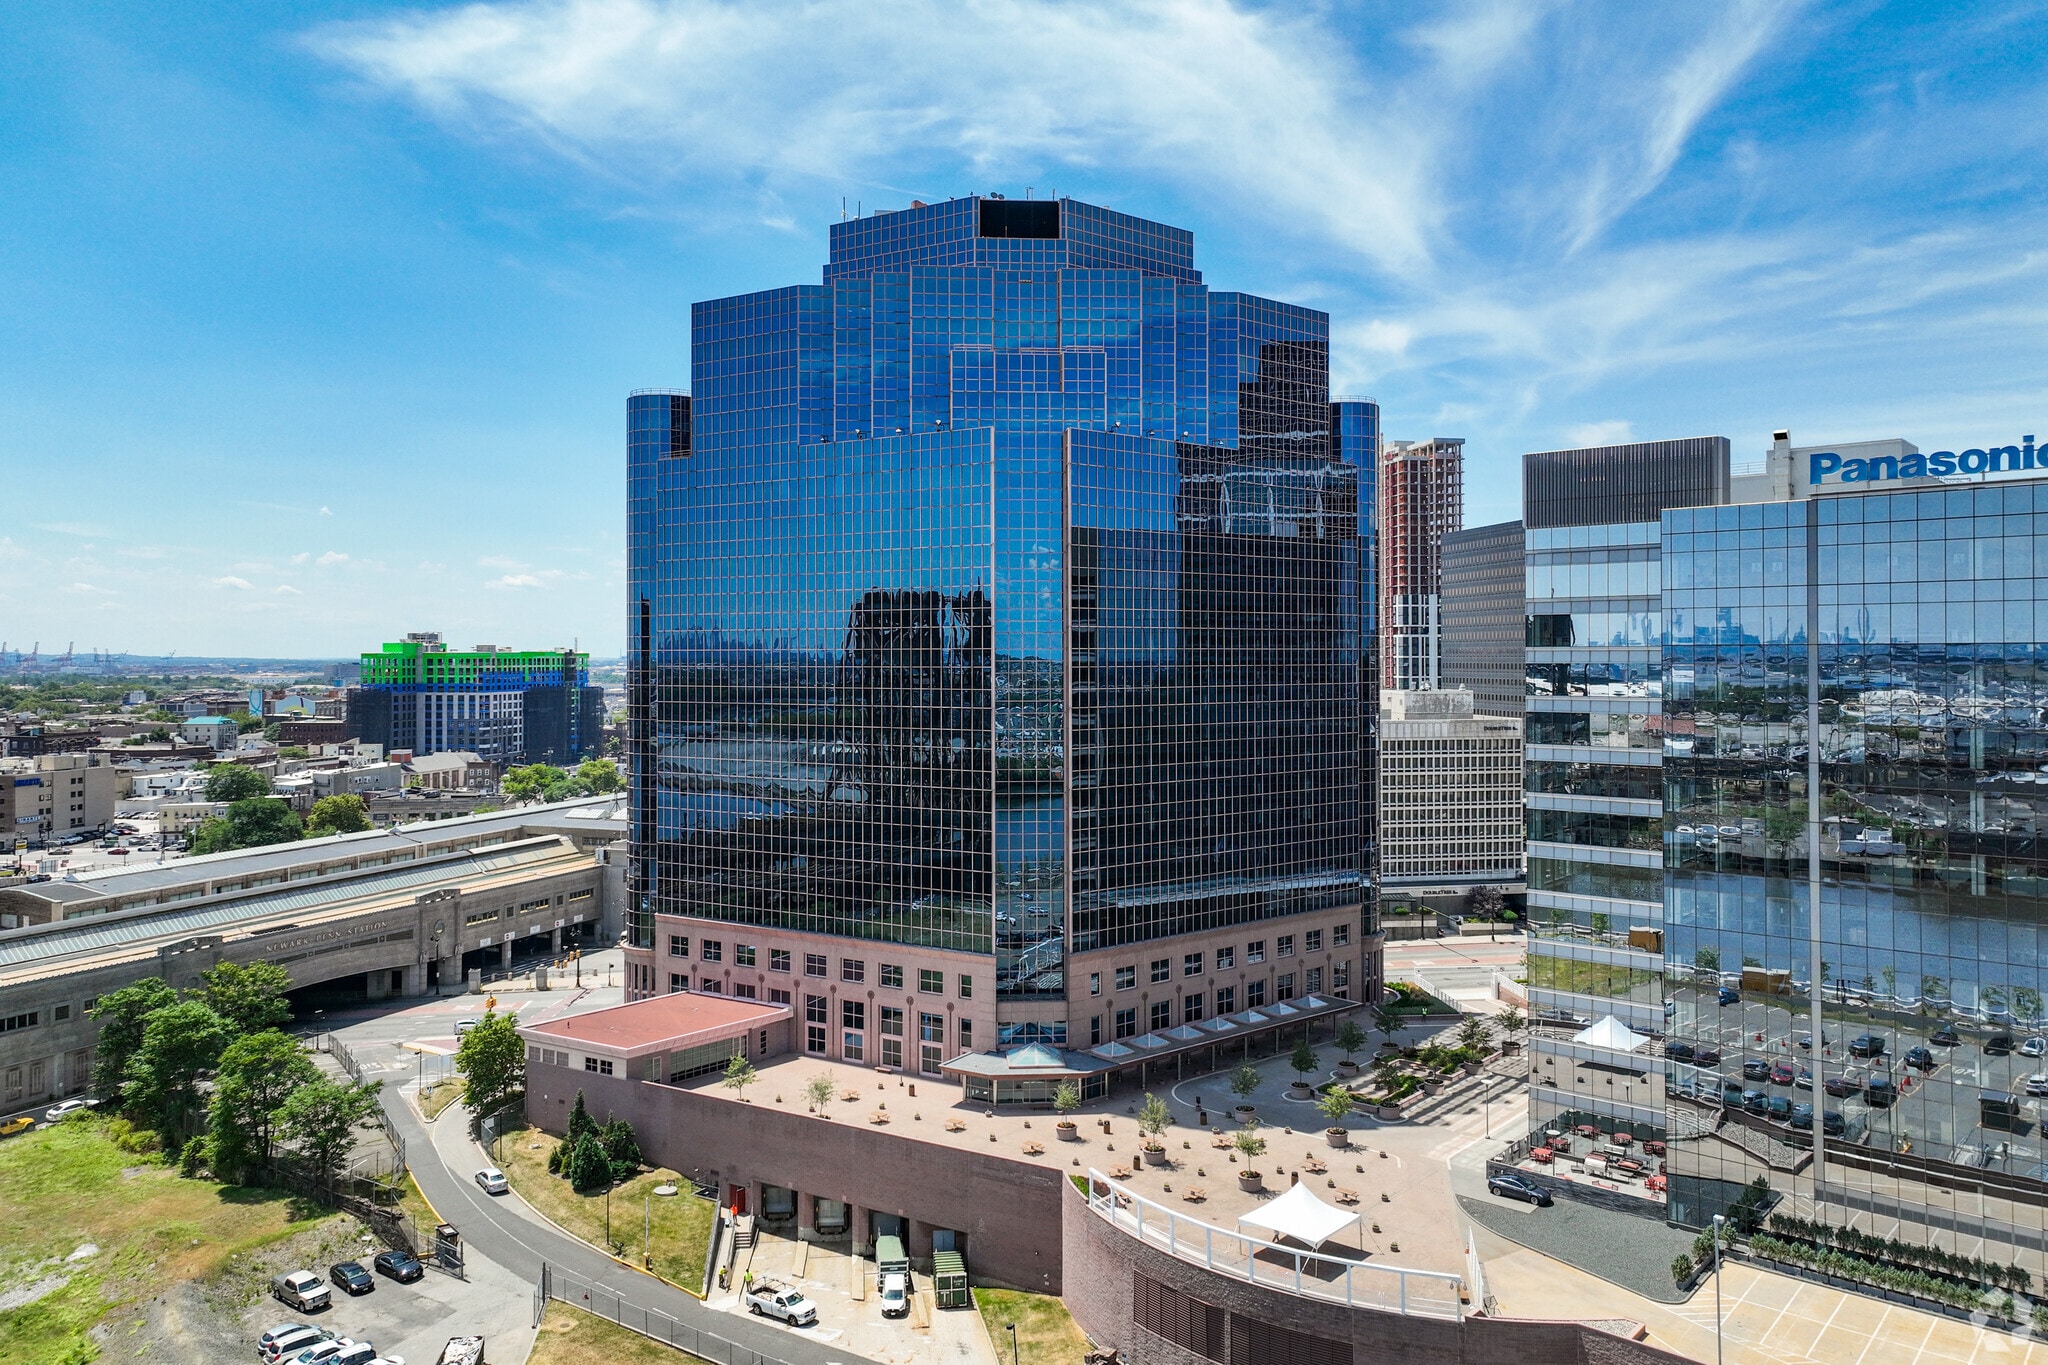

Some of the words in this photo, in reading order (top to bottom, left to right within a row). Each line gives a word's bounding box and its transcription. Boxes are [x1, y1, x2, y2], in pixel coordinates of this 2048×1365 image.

[266, 937, 309, 952] NEWARK
[316, 931, 341, 943] PENN
[347, 920, 388, 935] STATION
